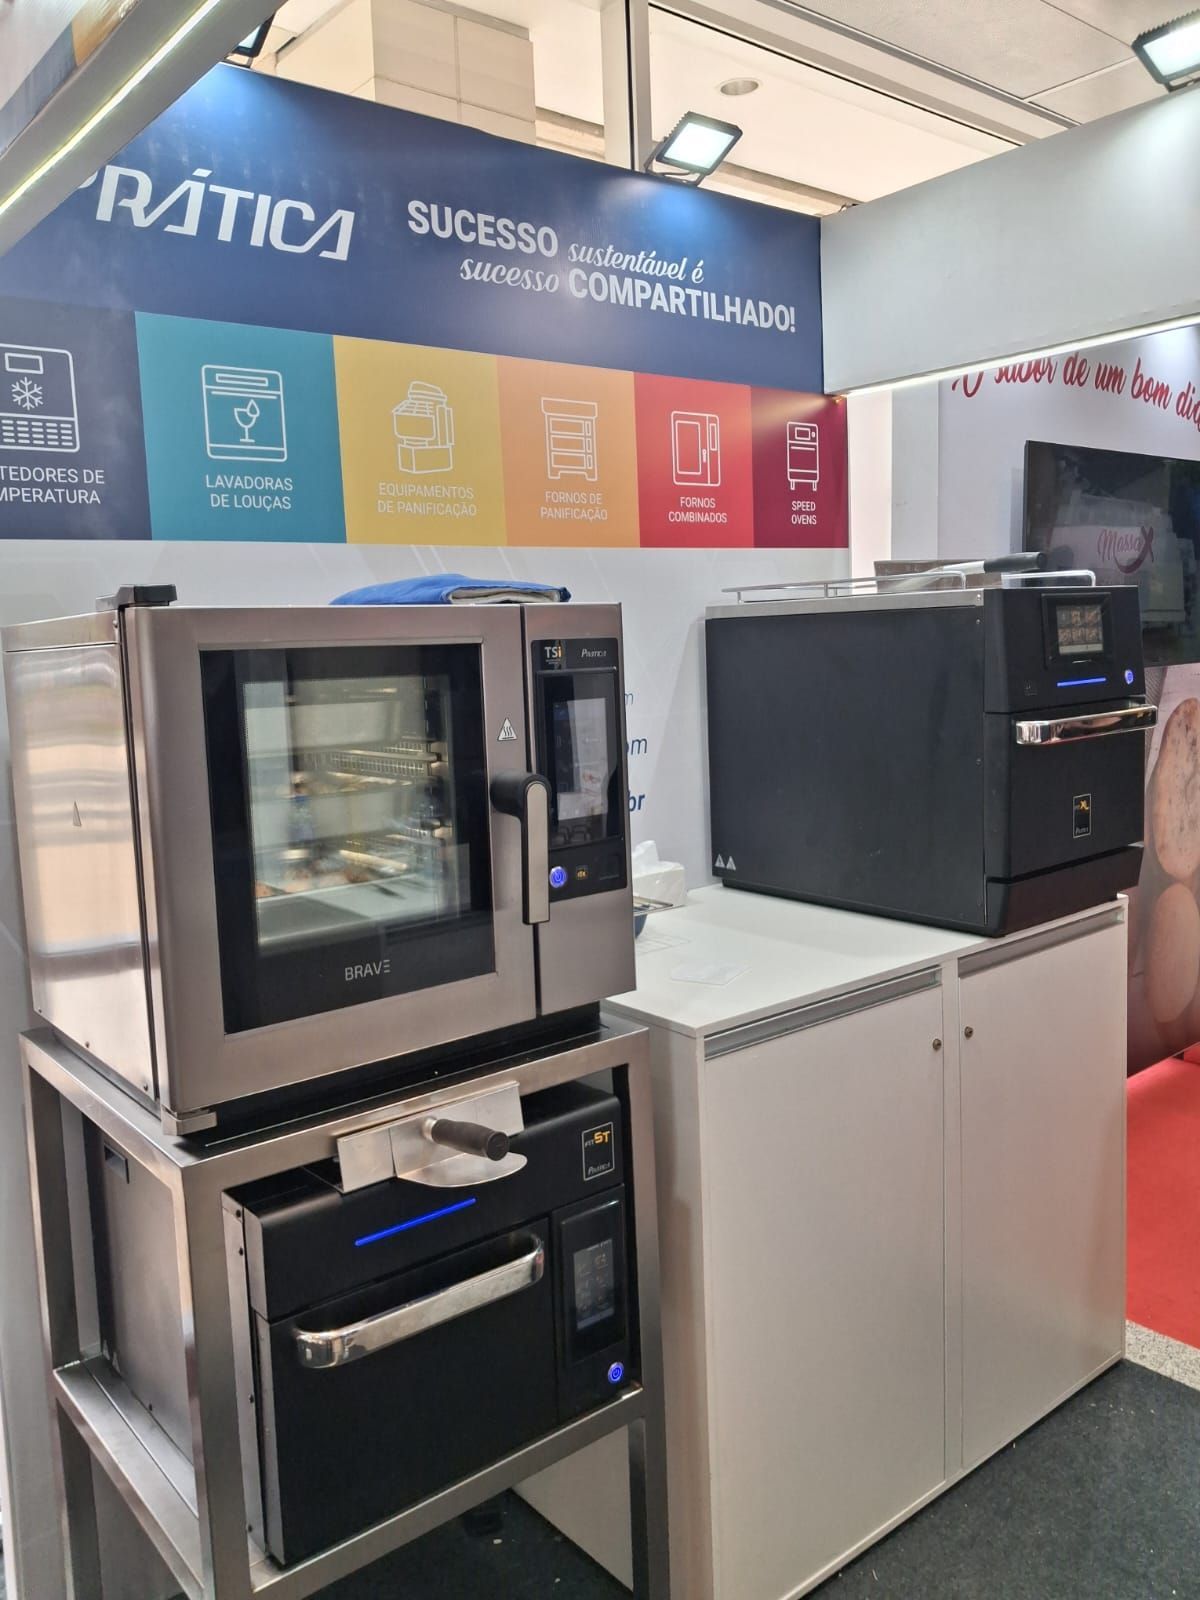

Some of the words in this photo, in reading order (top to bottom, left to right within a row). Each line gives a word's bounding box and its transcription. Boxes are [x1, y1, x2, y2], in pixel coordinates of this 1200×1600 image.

[78, 165, 355, 261] RÁTICA
[407, 199, 559, 258] SUCESSO
[568, 243, 688, 281] sustentável
[691, 259, 705, 284] é
[459, 258, 560, 293] sucesso
[568, 267, 796, 334] COMPARTILHADO!
[1062, 351, 1091, 387] de
[1095, 361, 1127, 395] um
[1130, 356, 1172, 410] bom
[0, 465, 79, 484] TEDORES
[83, 468, 105, 485] DE
[205, 474, 294, 492] LAVADORAS
[0, 486, 101, 505] MPERATURA
[378, 482, 475, 500] EQUIPAMENTOS
[545, 490, 587, 505] FORNOS
[589, 492, 604, 505] DE
[210, 493, 231, 508] DE
[233, 494, 292, 513] LOUÇAS
[377, 500, 394, 514] DE
[397, 500, 478, 520] PANIFICAÇÃO
[679, 496, 716, 509] FORNOS
[791, 500, 816, 512] SPEED
[540, 505, 609, 524] PANIFICAÇÃO
[668, 511, 728, 524] COMBINADOS
[791, 514, 817, 526] OVENS
[544, 646, 563, 658] TSi
[344, 959, 391, 981] BRAVE
